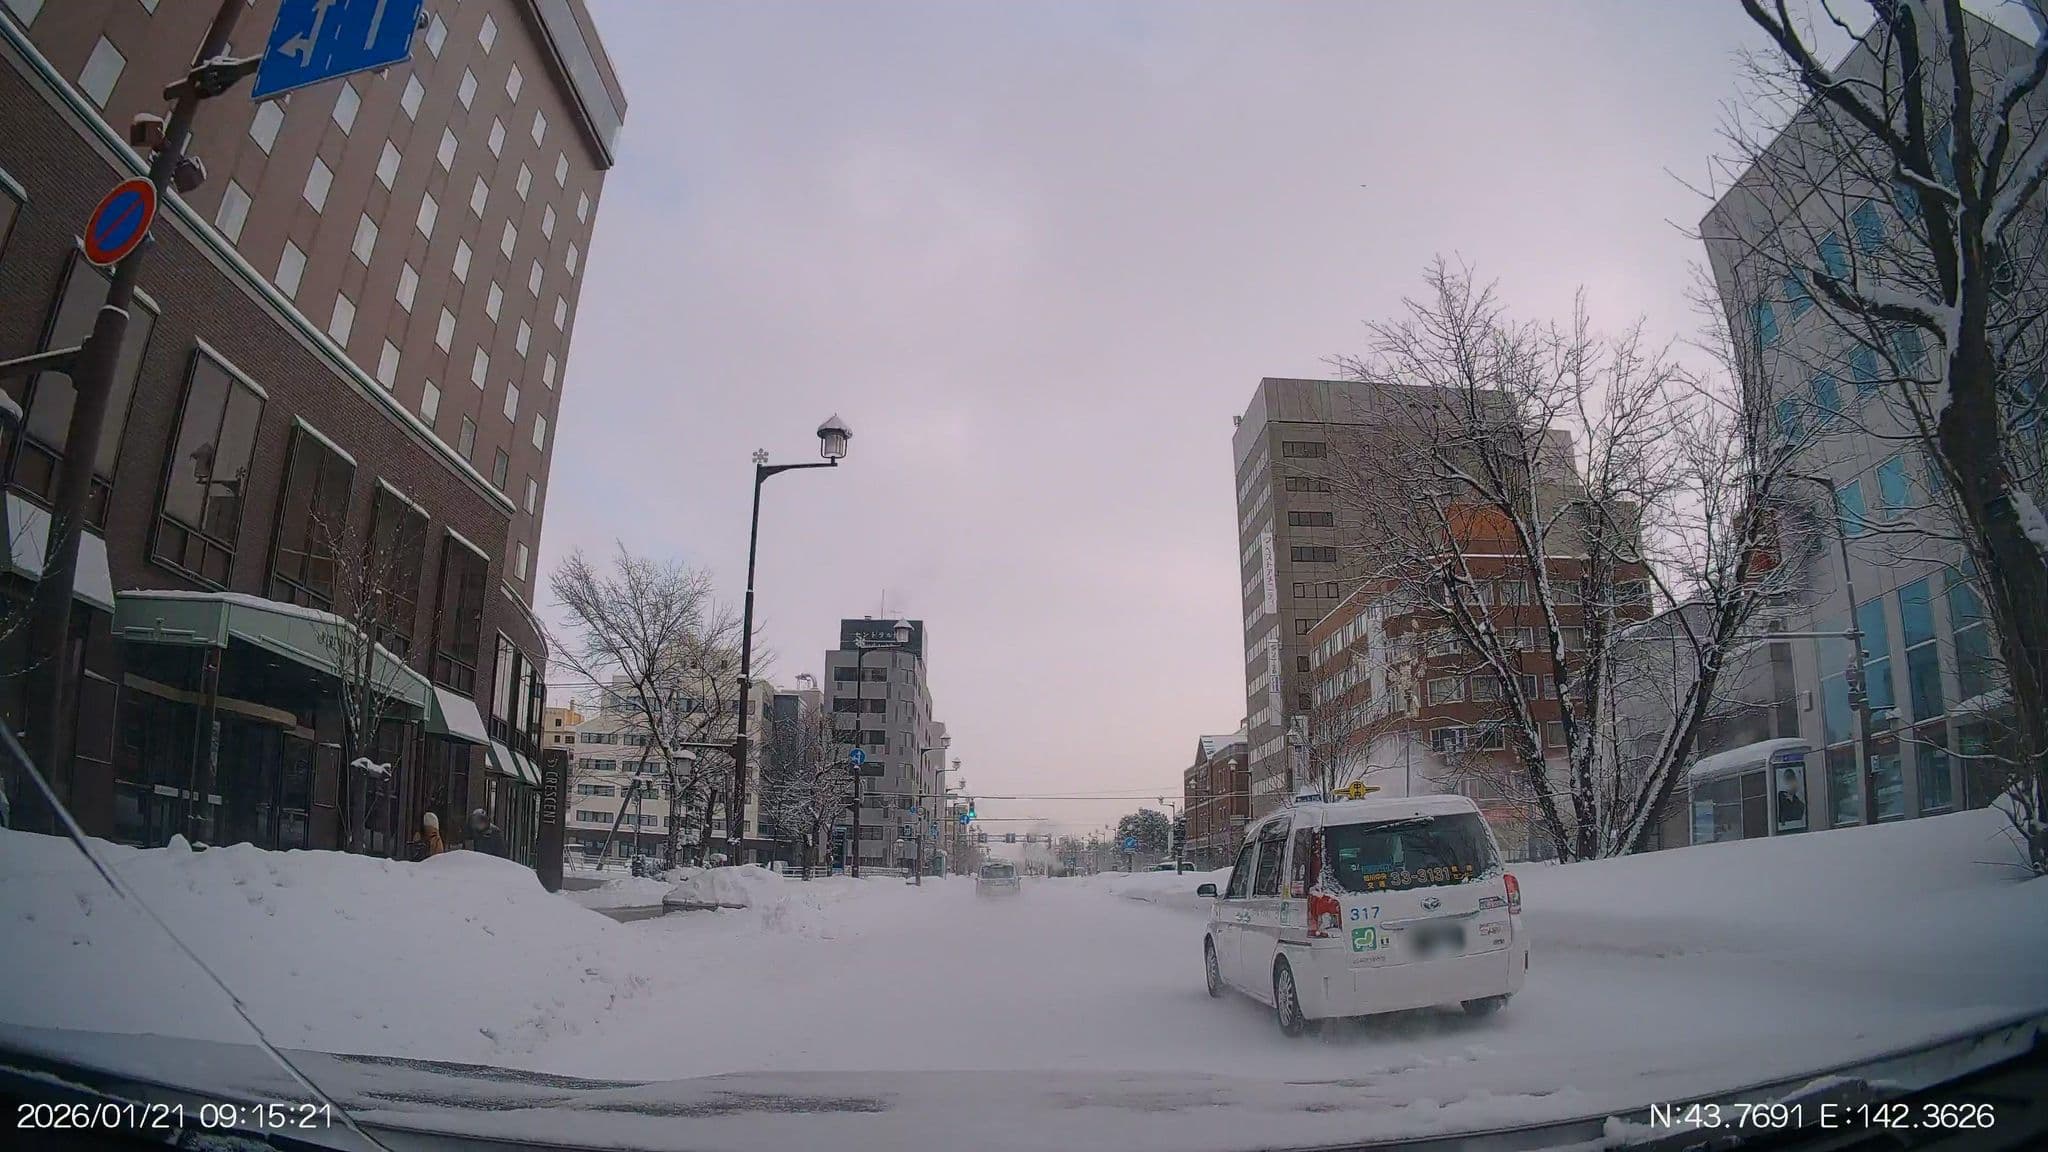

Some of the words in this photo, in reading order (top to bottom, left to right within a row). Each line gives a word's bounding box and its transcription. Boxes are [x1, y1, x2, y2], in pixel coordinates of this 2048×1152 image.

[544, 771, 559, 825] CRESCENT
[1390, 866, 1451, 886] 33-3131
[1350, 906, 1380, 921] 317
